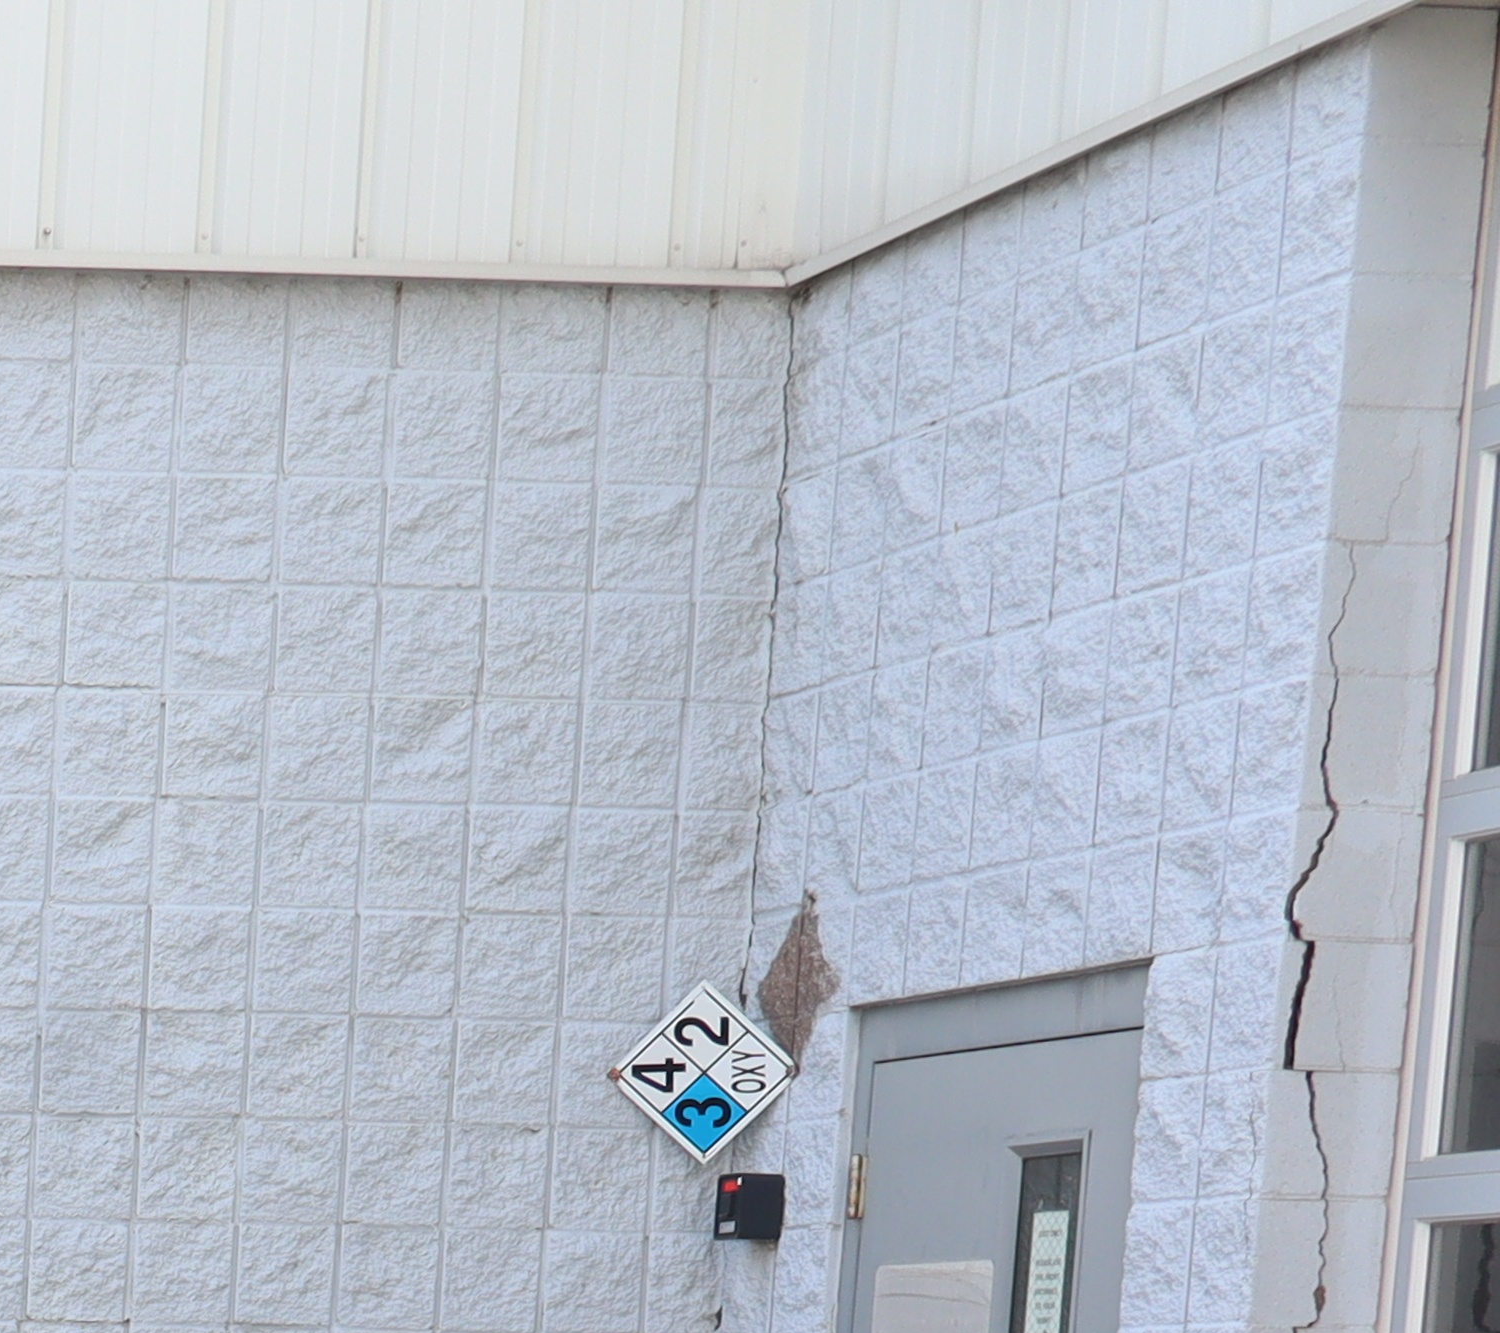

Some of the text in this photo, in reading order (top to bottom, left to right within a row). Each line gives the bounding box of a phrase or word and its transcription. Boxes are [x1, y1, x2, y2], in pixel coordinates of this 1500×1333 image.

[673, 1016, 730, 1047] 2
[631, 1057, 687, 1094] 4
[730, 1049, 767, 1094] OXY
[674, 1096, 733, 1129] 3
